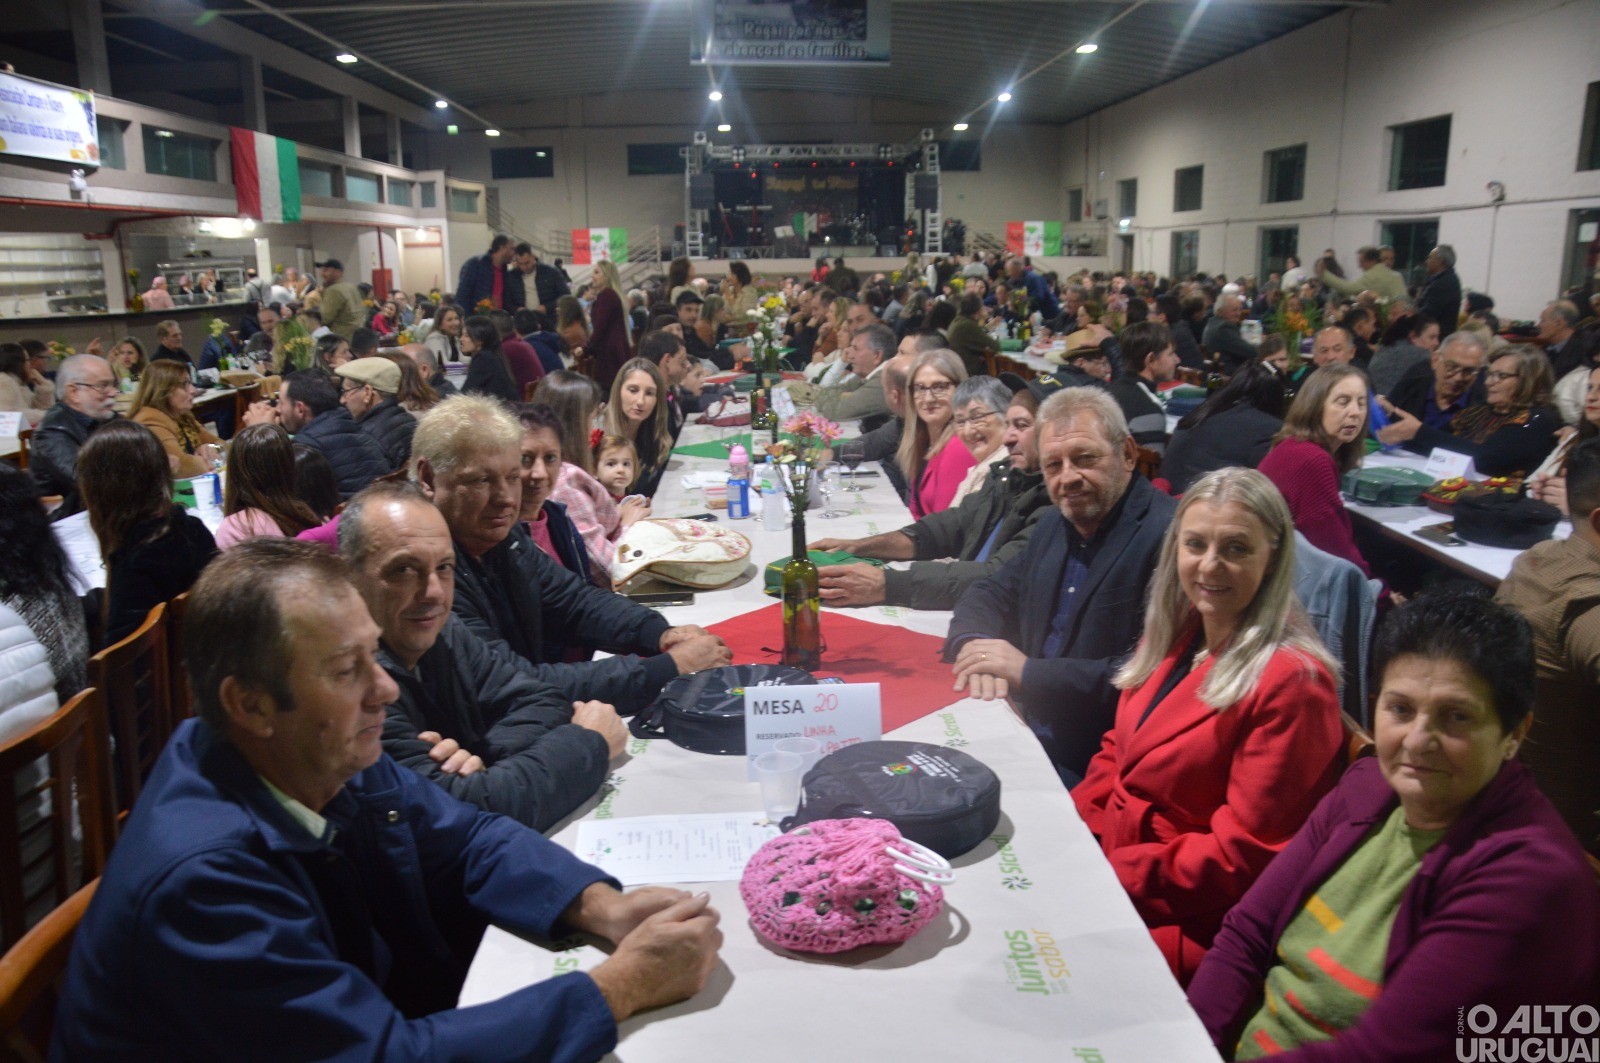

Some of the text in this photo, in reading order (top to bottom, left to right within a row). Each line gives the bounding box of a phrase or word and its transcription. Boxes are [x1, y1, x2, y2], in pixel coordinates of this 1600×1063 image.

[744, 20, 782, 39] Rogai
[787, 24, 809, 39] por
[753, 699, 805, 715] MESA
[813, 692, 839, 713] 20
[990, 834, 1024, 874] Sicredi
[1004, 929, 1049, 996] Juntos
[1031, 928, 1072, 979] sabor
